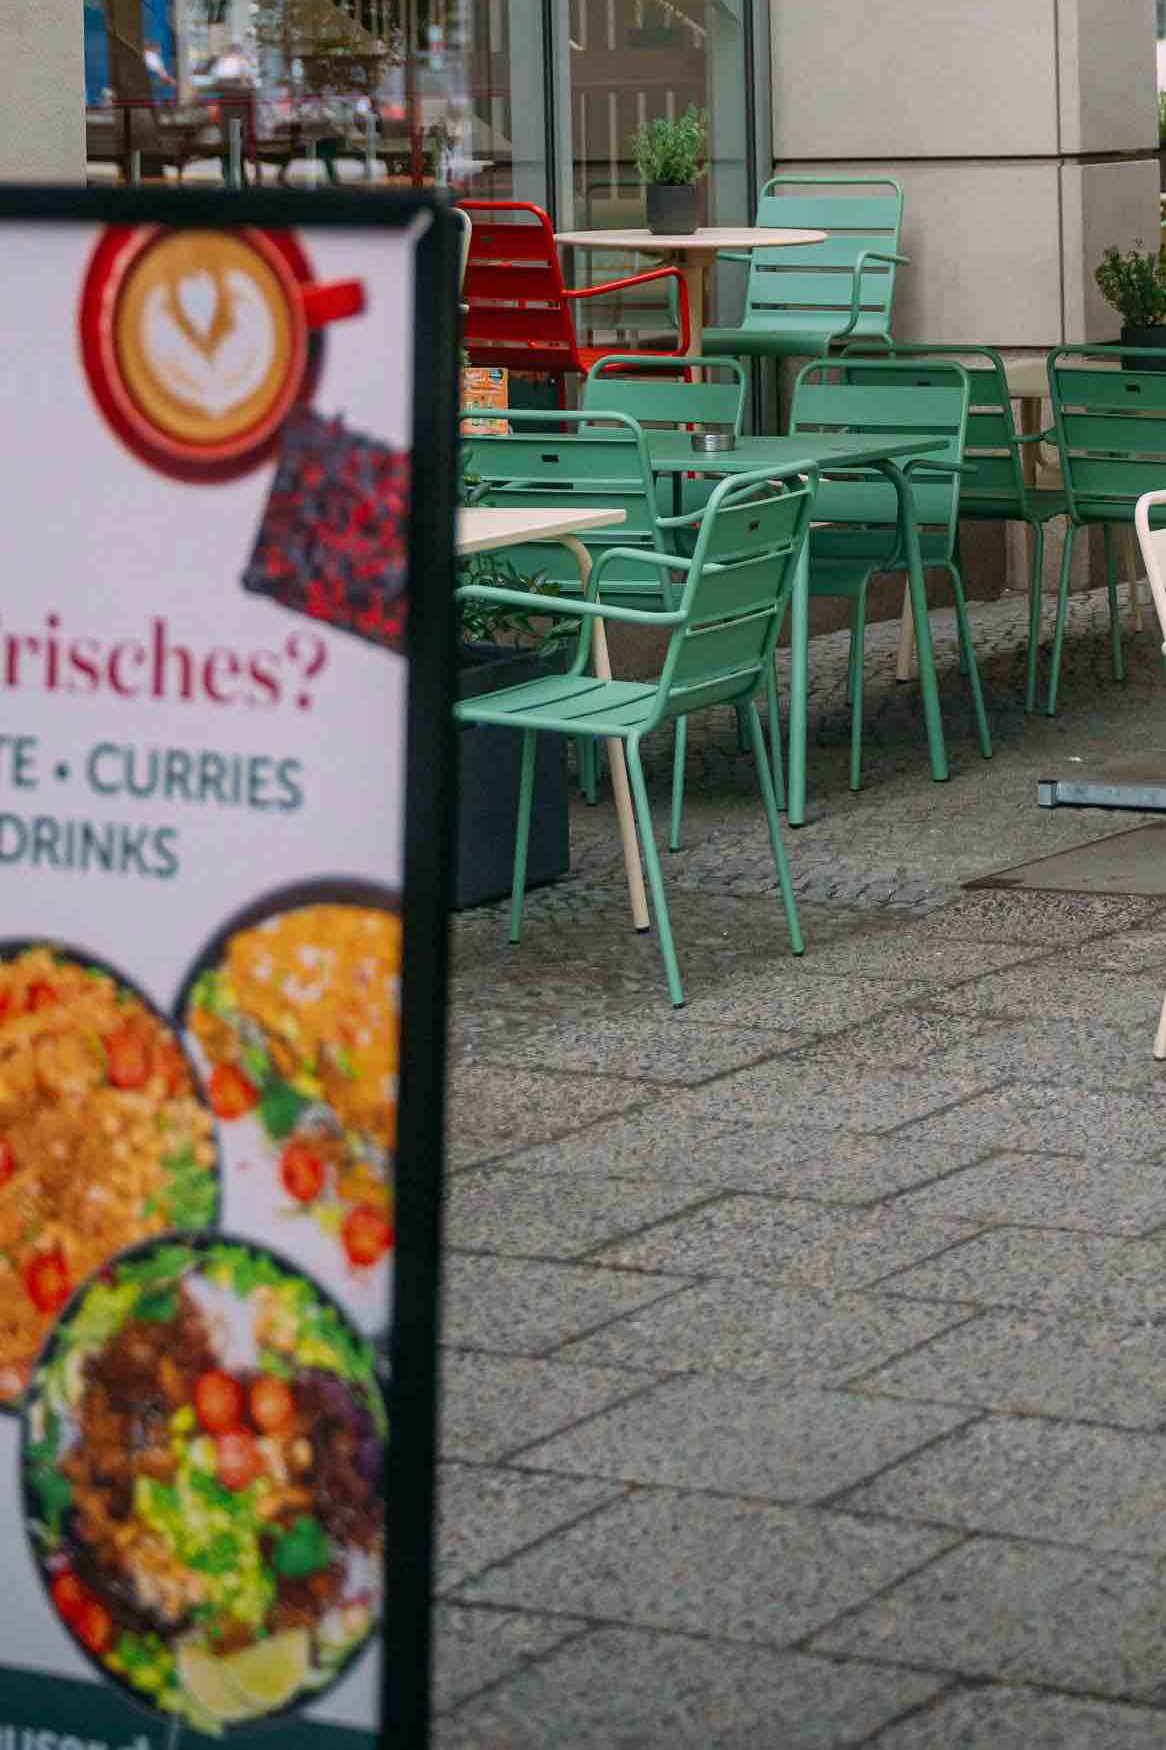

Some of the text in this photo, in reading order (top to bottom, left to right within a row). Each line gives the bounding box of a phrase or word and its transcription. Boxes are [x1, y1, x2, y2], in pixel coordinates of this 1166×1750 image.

[0, 611, 328, 711] risches?
[86, 741, 304, 812] CURRIES
[0, 813, 180, 881] DRINKS
